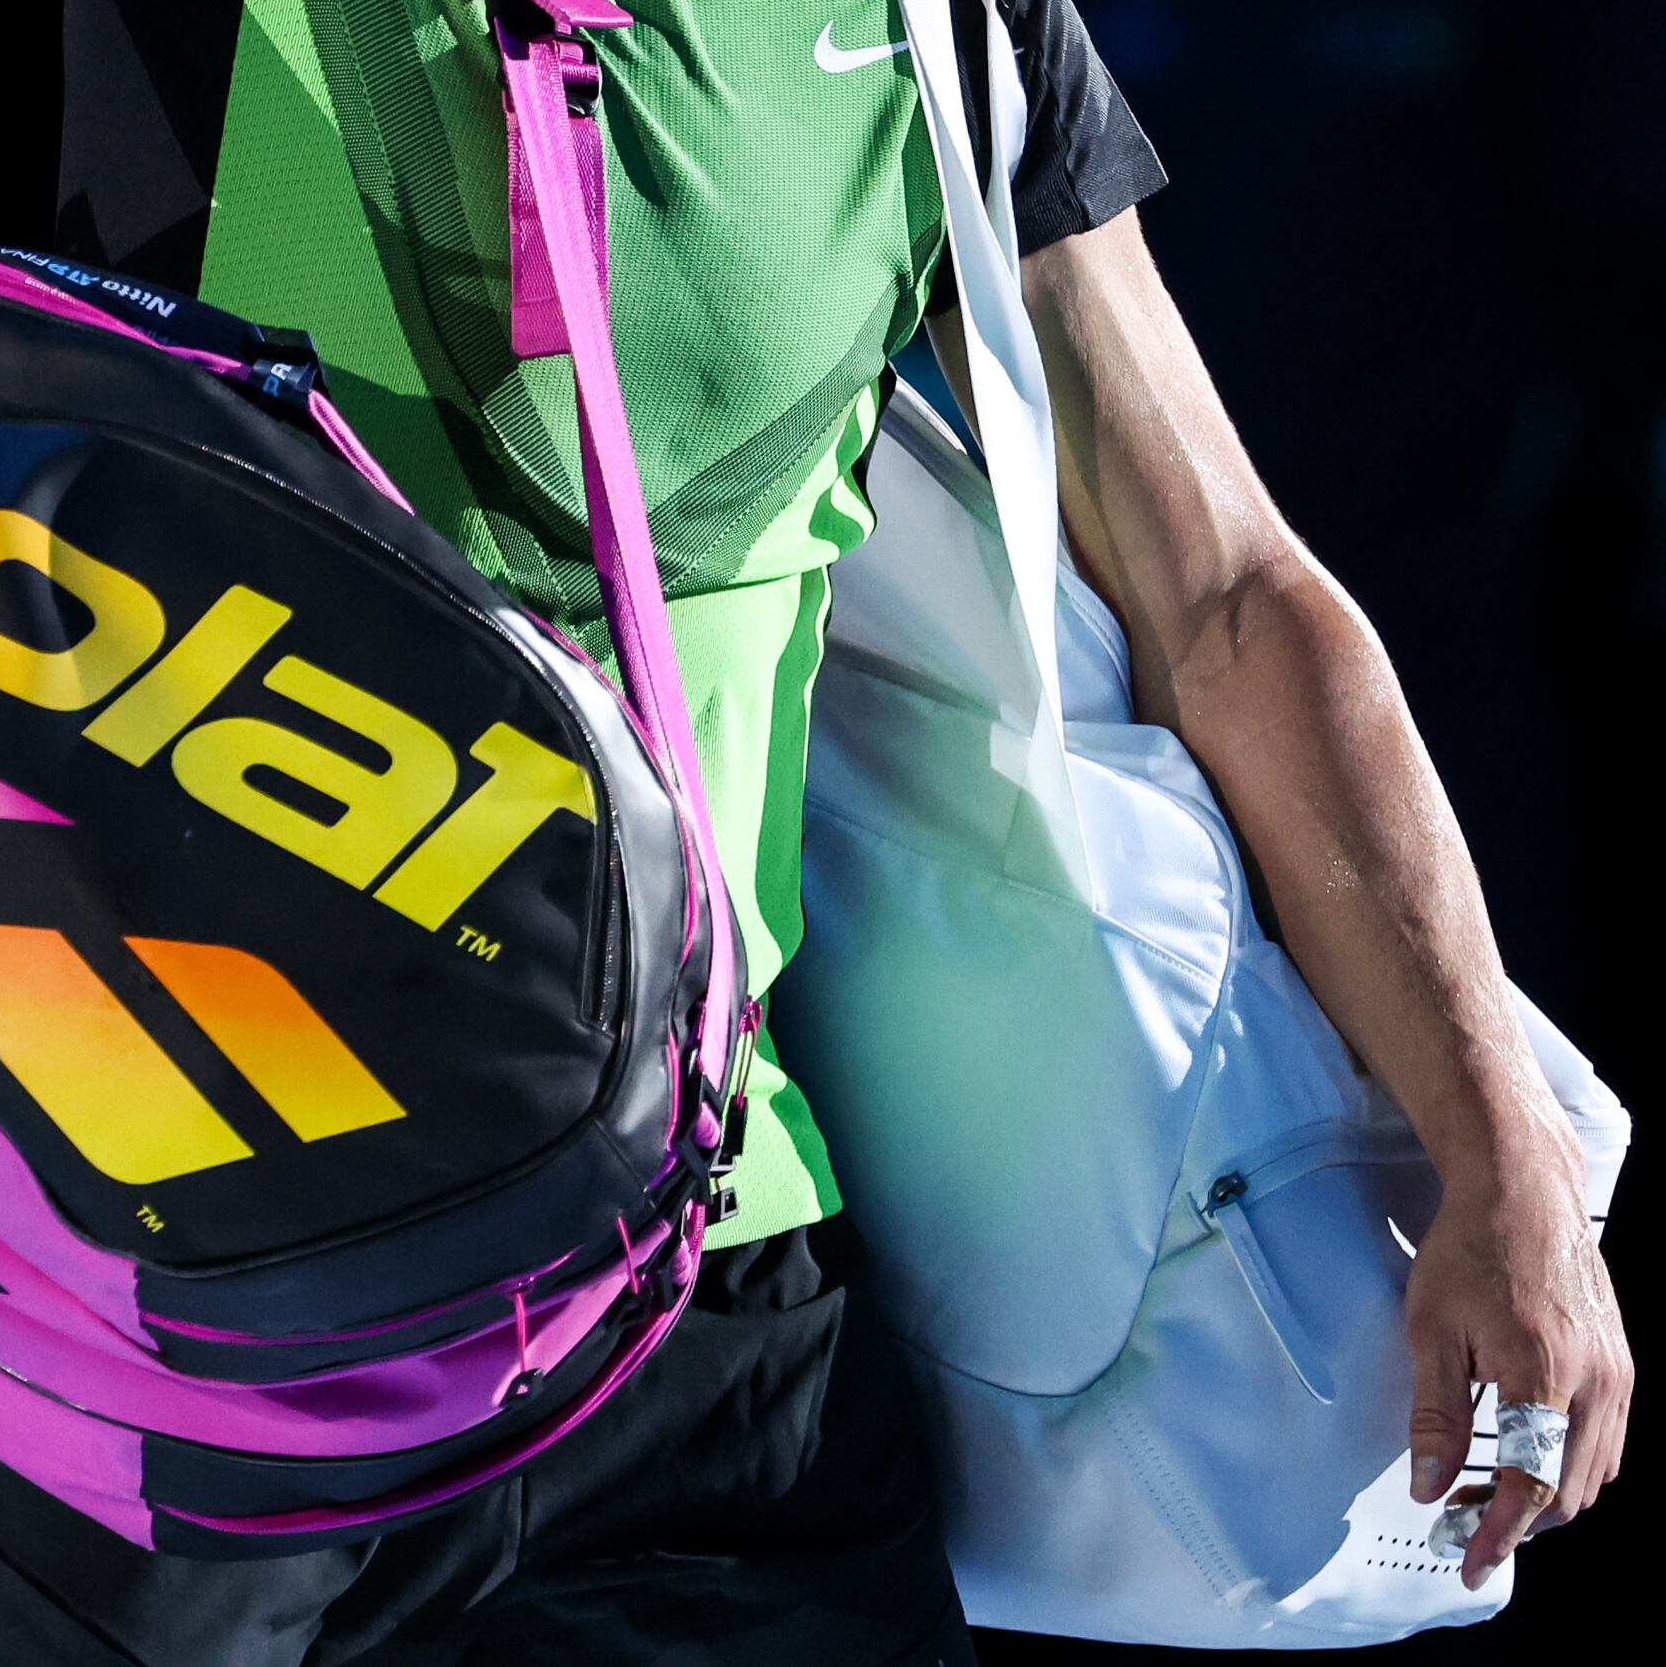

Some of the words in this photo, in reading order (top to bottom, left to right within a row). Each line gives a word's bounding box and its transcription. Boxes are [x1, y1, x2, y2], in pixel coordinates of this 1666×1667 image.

[102, 279, 177, 318] Nitto
[455, 924, 503, 963] TM
[135, 1203, 166, 1233] TM
